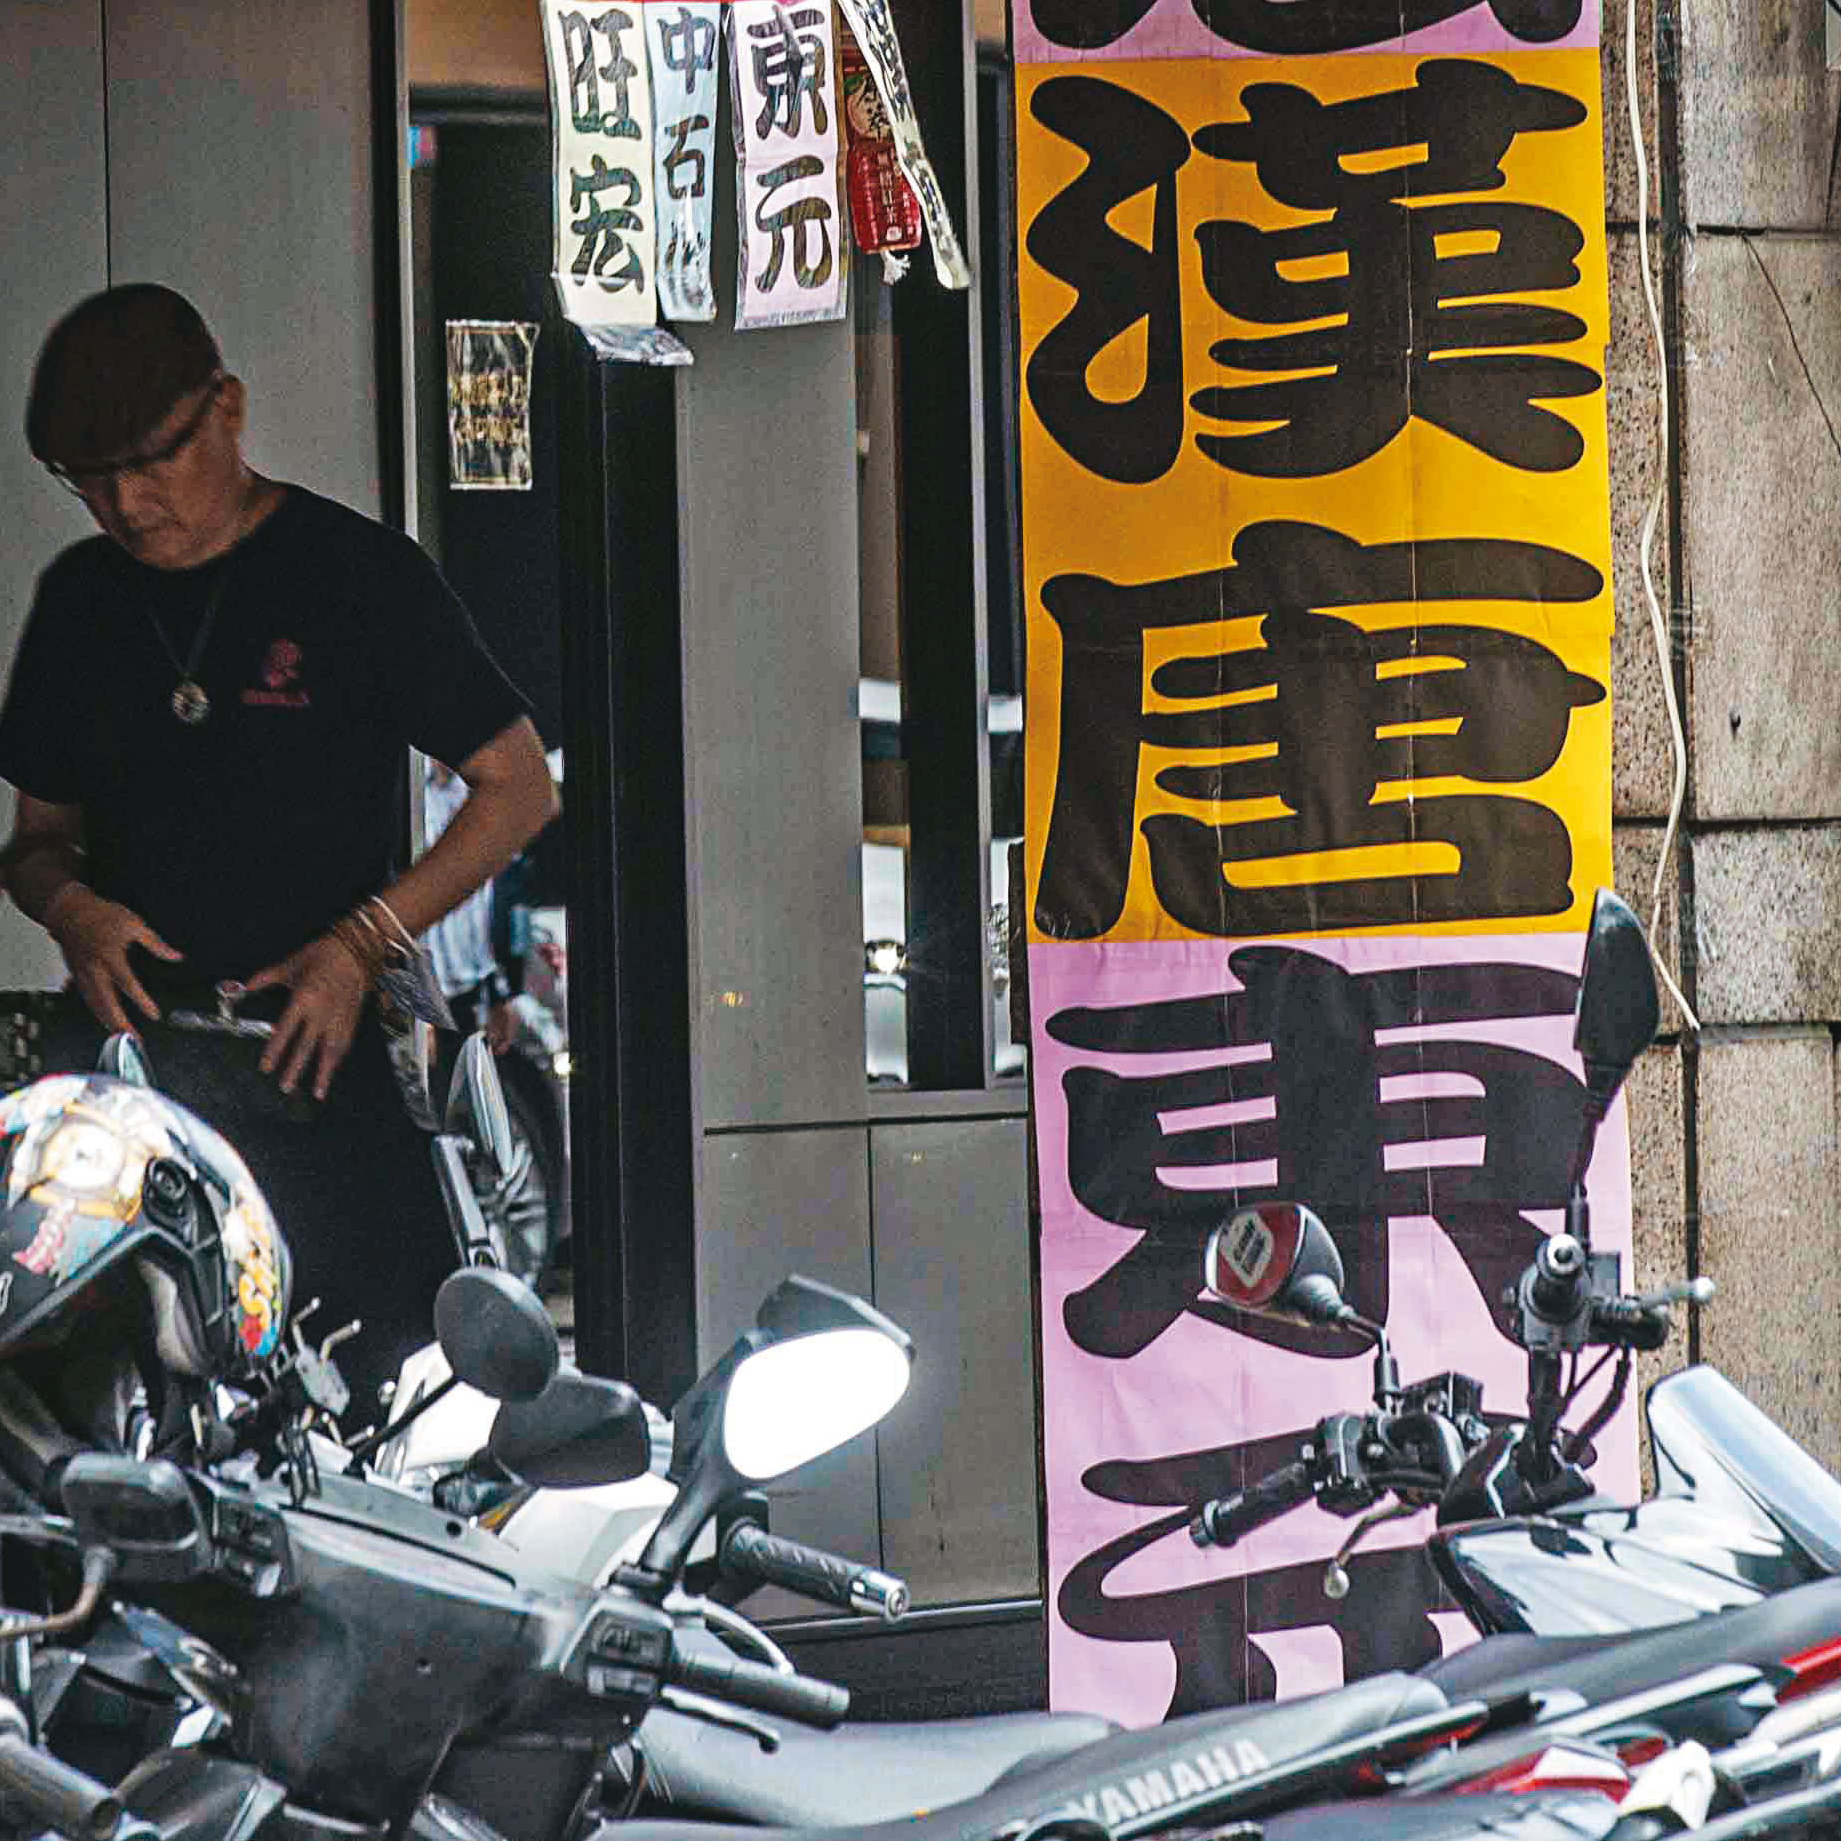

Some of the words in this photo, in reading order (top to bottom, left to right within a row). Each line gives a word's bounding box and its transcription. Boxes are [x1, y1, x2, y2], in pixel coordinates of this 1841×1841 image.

[558, 7, 644, 295] 旺宏
[746, 4, 833, 293] 東元
[1025, 59, 1606, 939] 漢唐
[1066, 1739, 1271, 1826] YAMAHA
